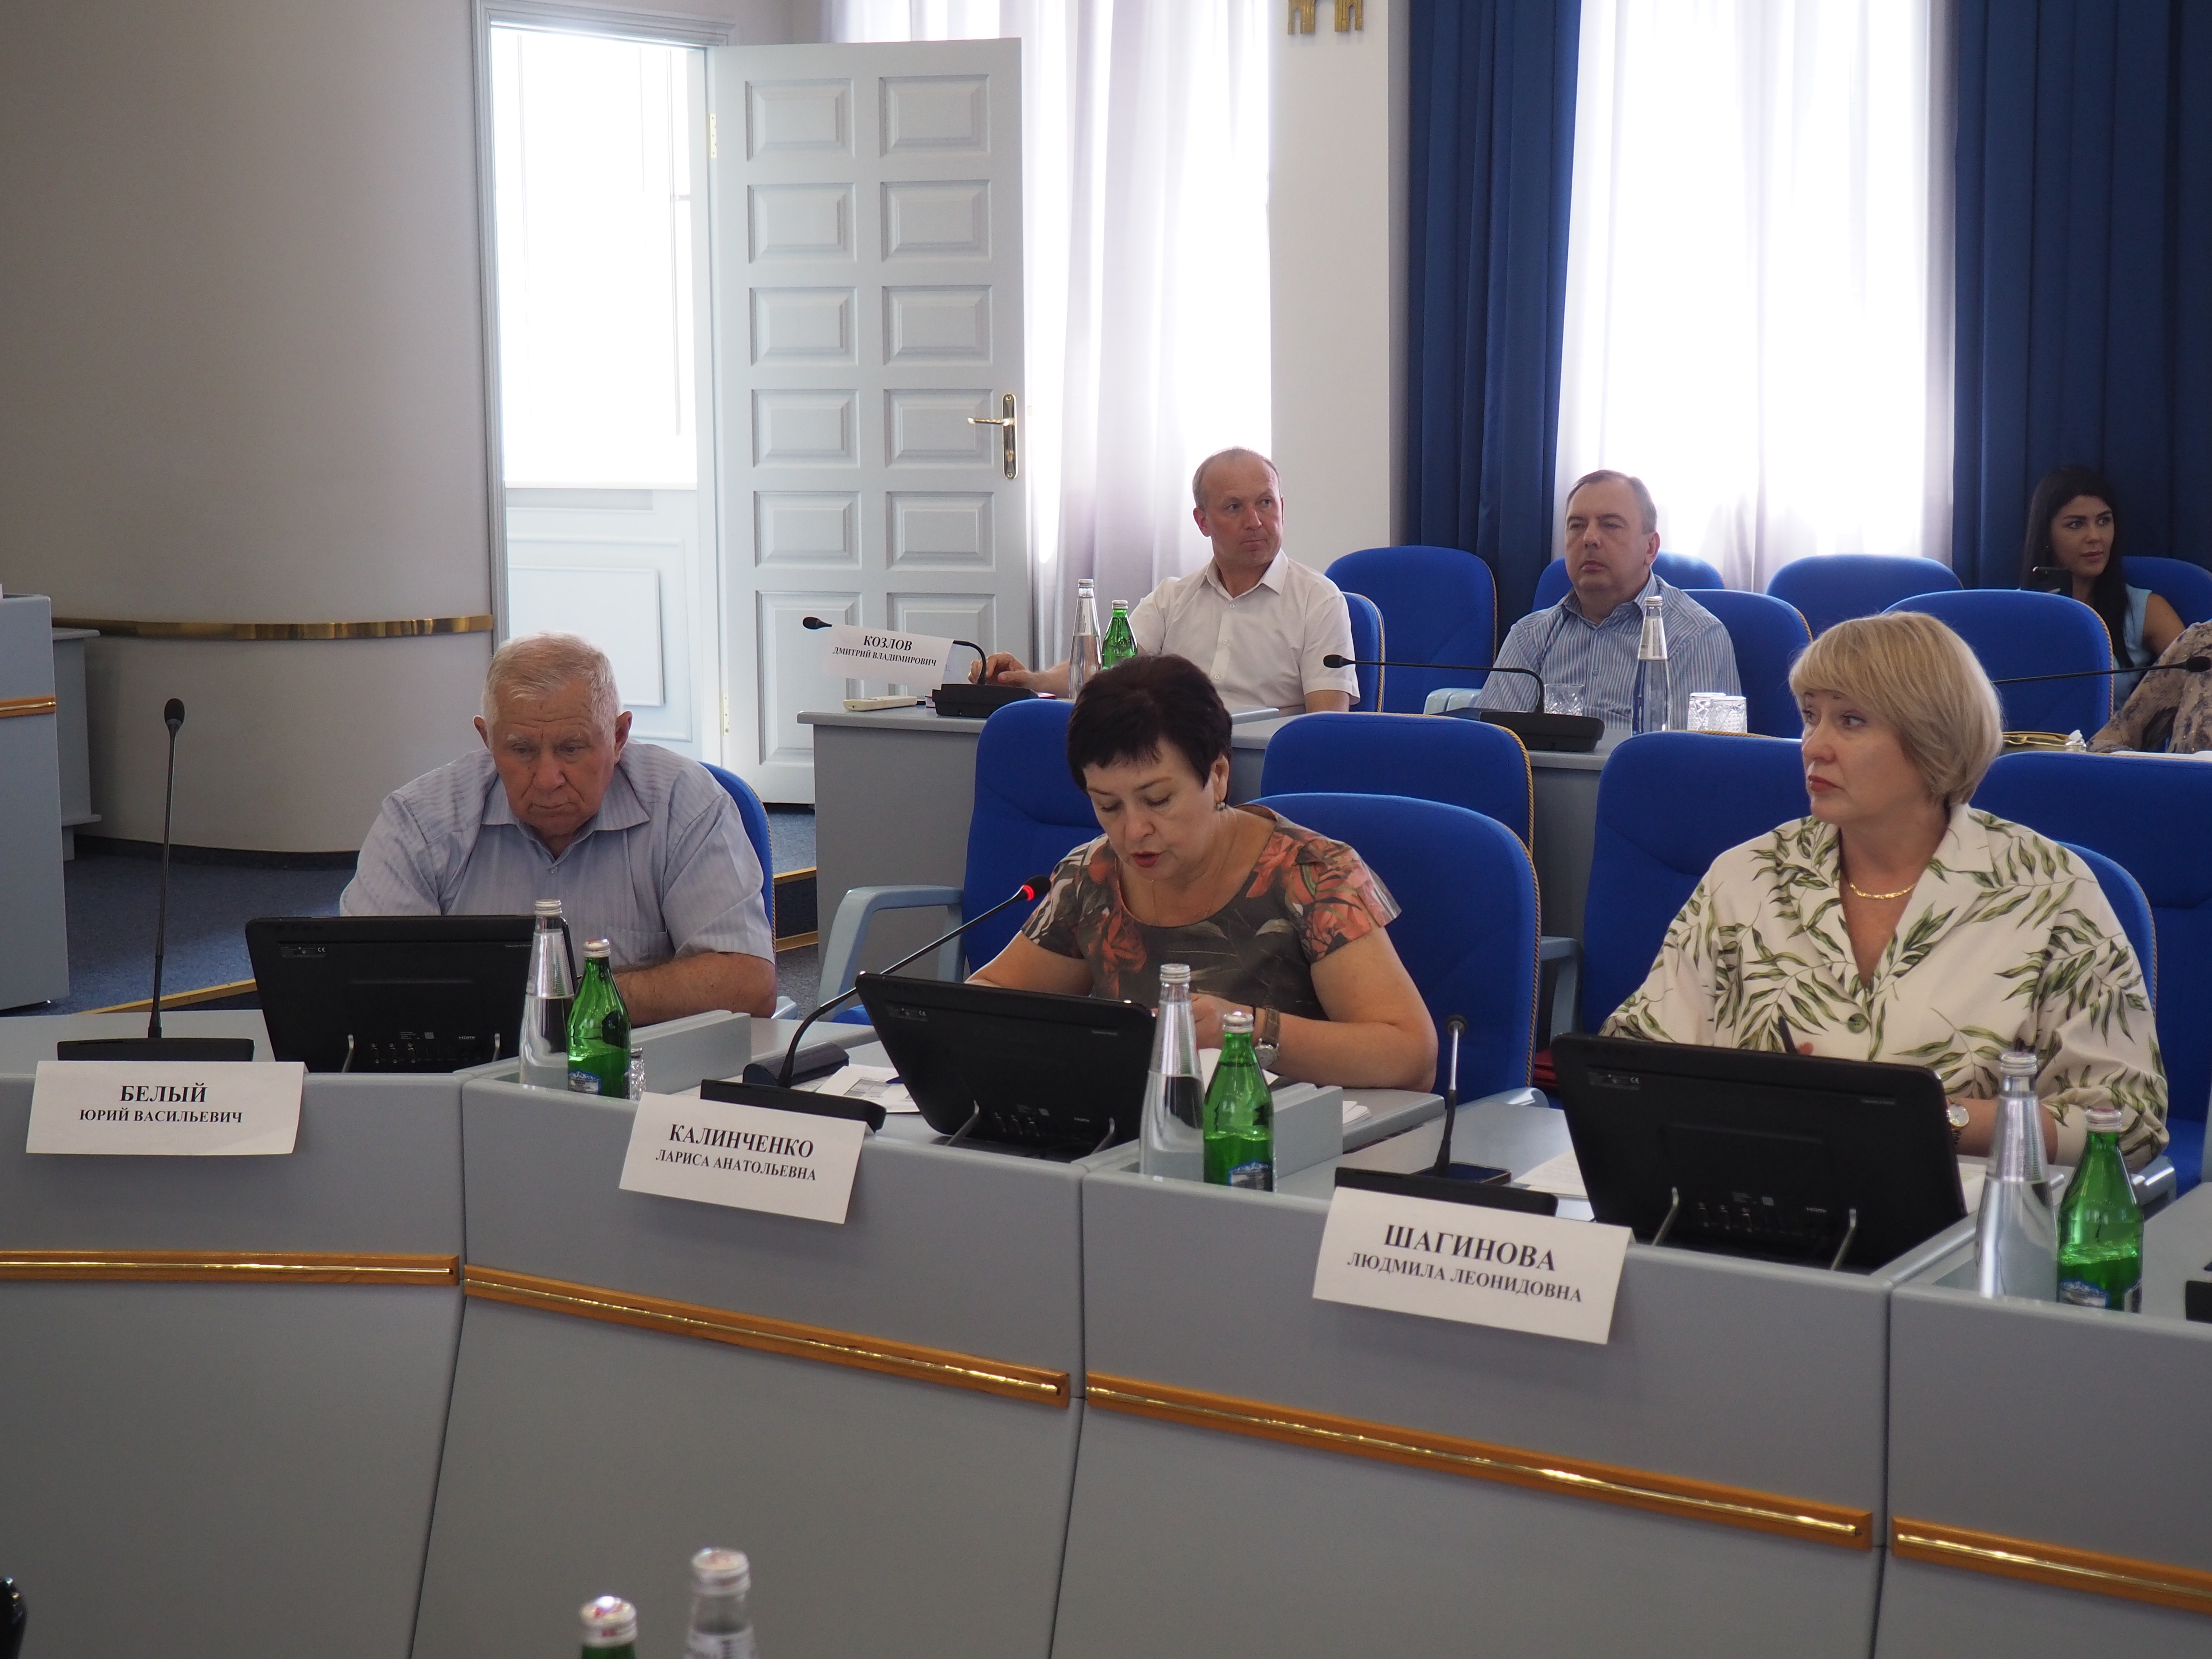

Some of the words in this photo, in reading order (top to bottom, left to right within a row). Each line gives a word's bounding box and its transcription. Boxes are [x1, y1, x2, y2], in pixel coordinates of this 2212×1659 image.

[863, 635, 912, 651] КОЗЛОВ
[832, 647, 871, 658] ДМИТРИЙ
[872, 652, 937, 666] ВЛАДИМИРОВИЧ
[120, 1082, 207, 1103] БЕЛЫЙ
[79, 1107, 130, 1121] ЮРИЙ
[134, 1110, 242, 1123] ВАСИЛЬЕВИЧ
[669, 1123, 814, 1158] КАЛИНЧЕНКО
[656, 1149, 709, 1167] ЛАРИСА
[713, 1157, 816, 1181] АНАТОЛЬЕВНА
[1384, 1224, 1555, 1272] ШАГИНОВА
[1347, 1252, 1445, 1281] ЛЮДМИЛА
[1450, 1269, 1582, 1302] ЛЕОНИДОВНА
